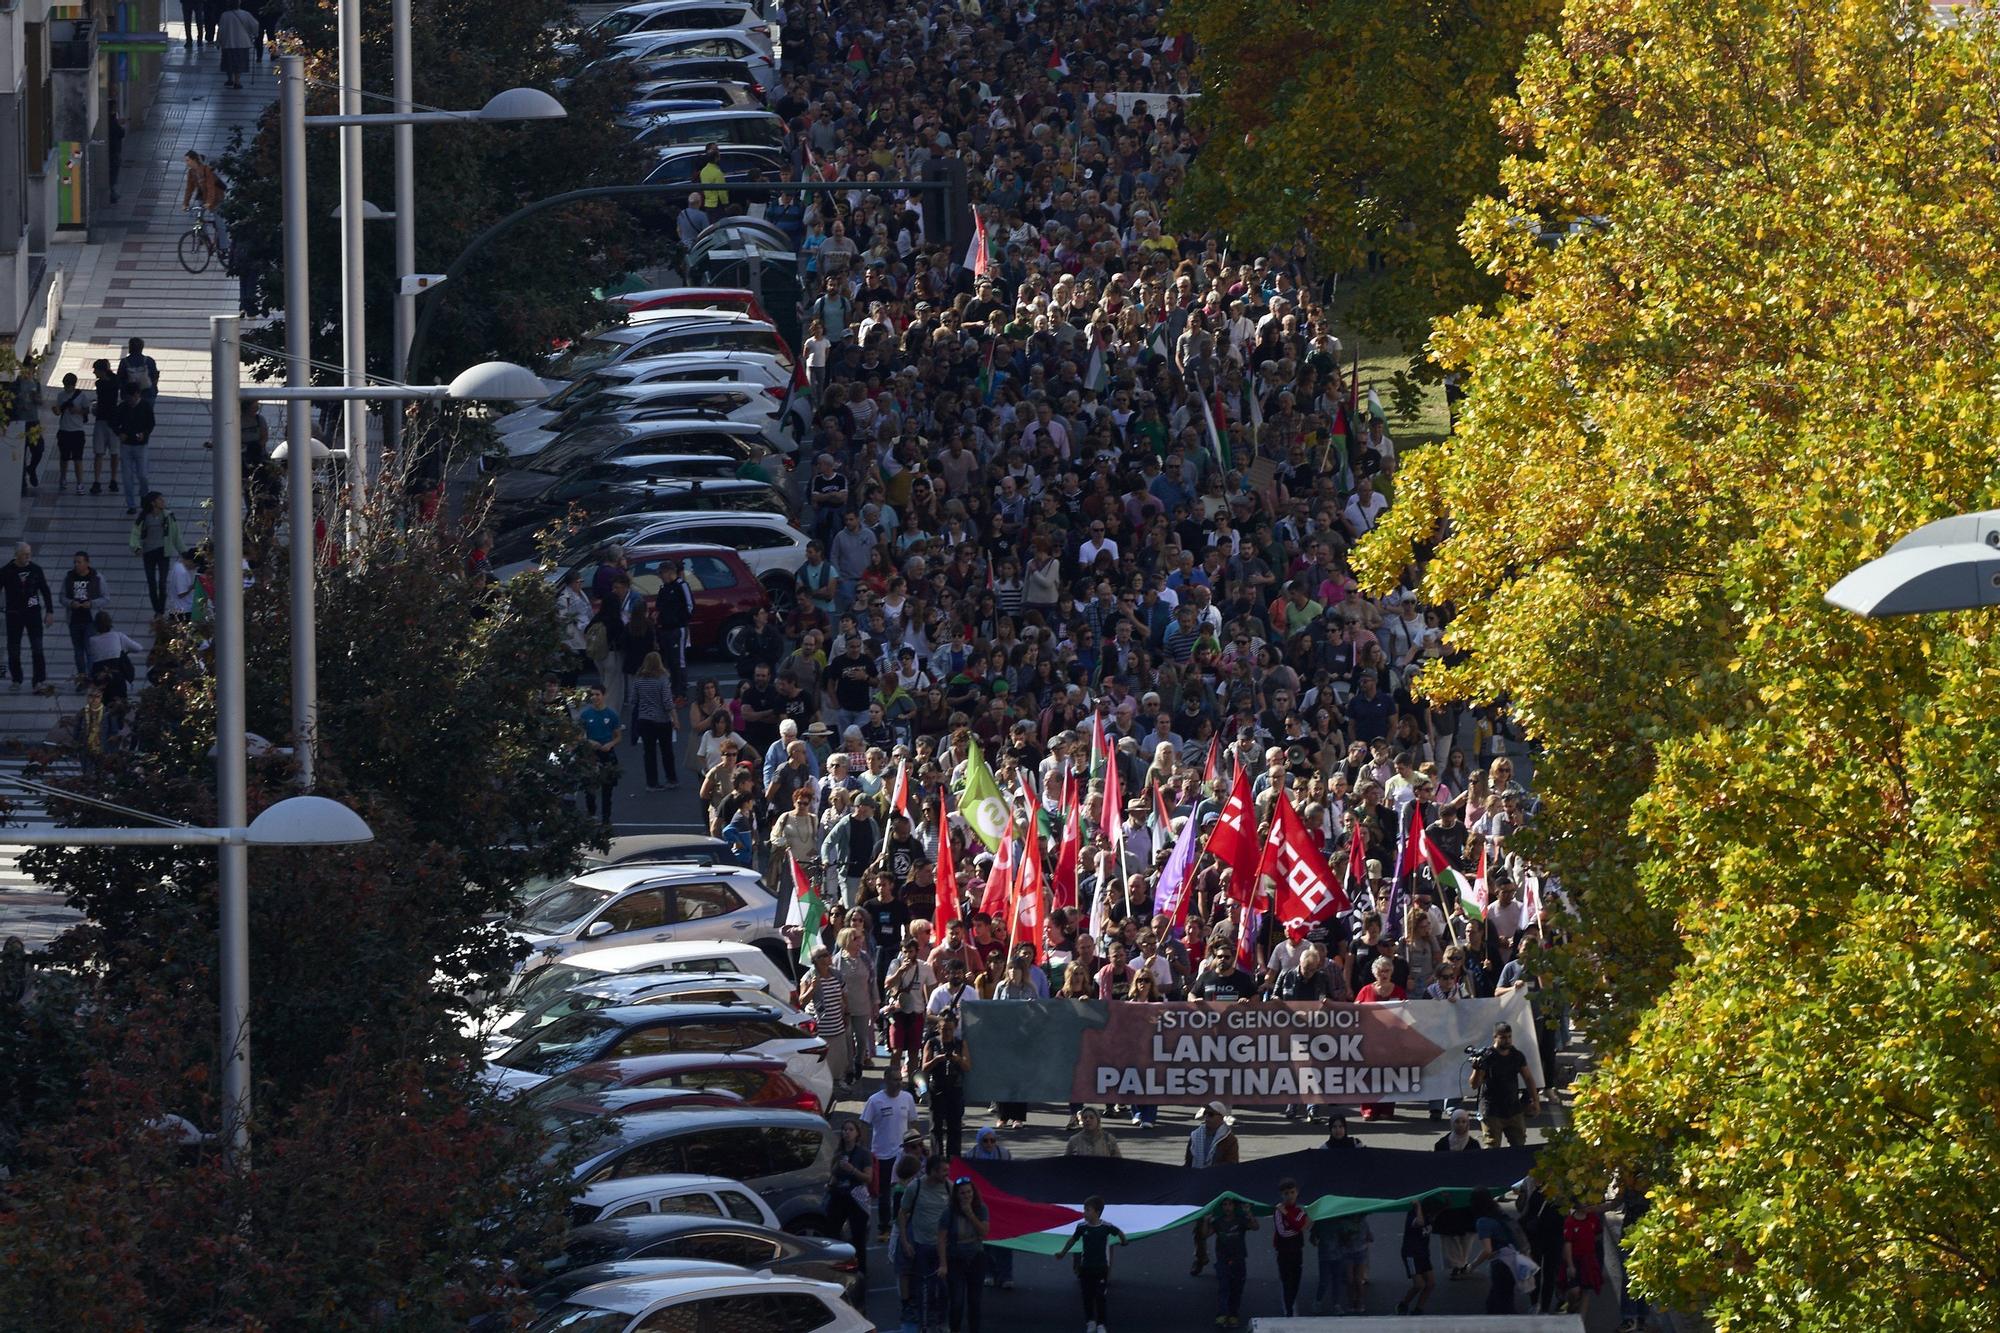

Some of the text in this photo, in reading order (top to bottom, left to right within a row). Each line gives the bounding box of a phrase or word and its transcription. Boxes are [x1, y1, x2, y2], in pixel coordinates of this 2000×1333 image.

[1156, 1009, 1360, 1033] ¡STOP GENOCIDIO!
[1153, 1033, 1365, 1063] LANGILEOK
[1096, 1065, 1423, 1097] PALESTINAREKIN!
